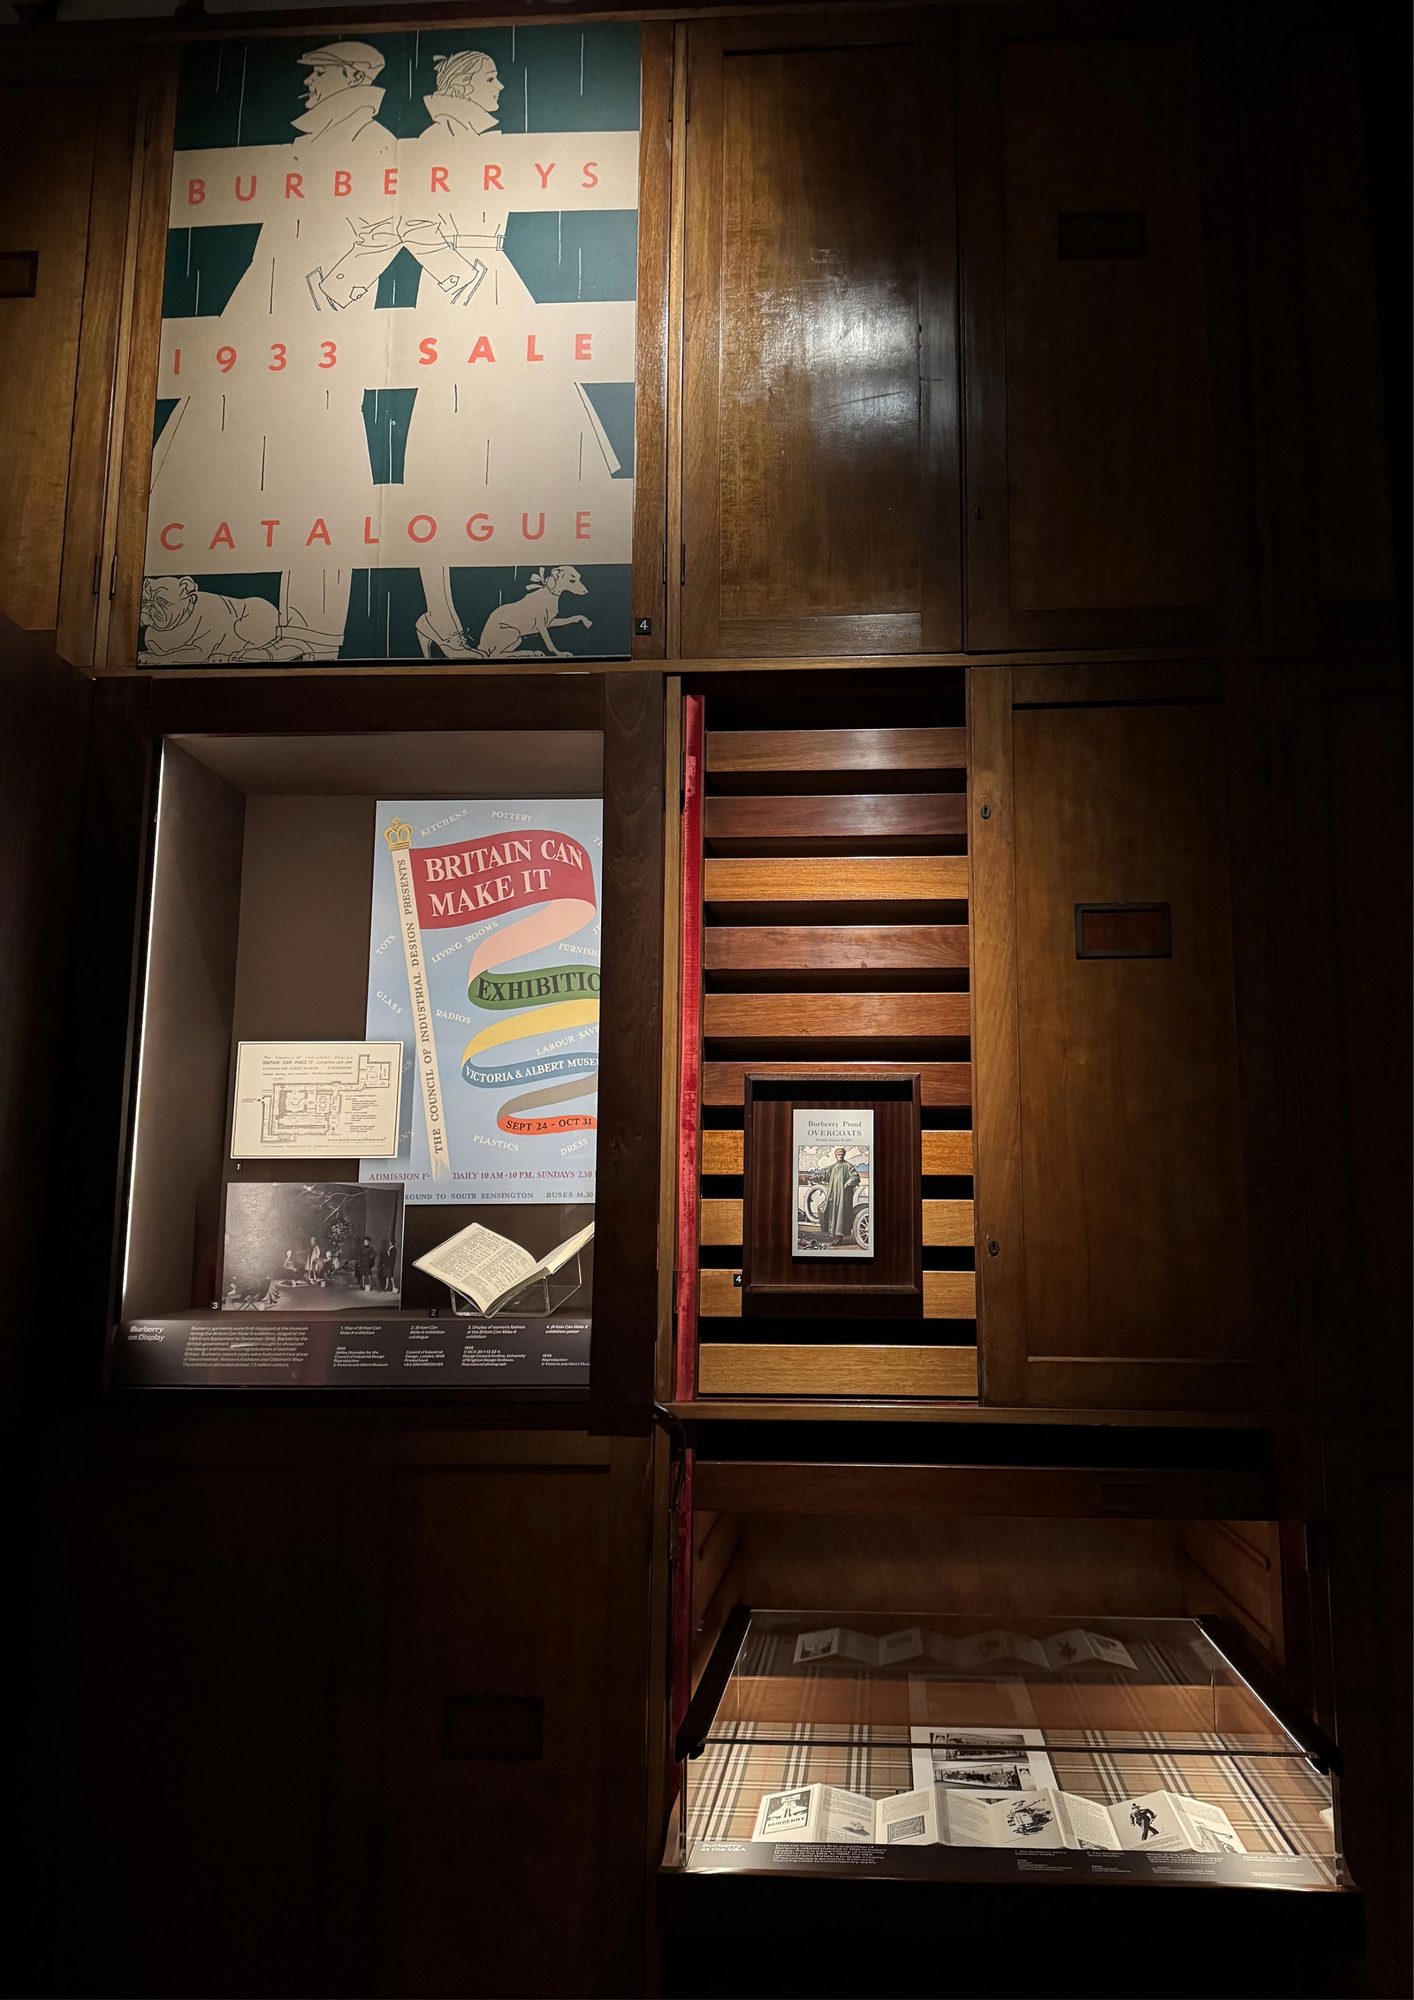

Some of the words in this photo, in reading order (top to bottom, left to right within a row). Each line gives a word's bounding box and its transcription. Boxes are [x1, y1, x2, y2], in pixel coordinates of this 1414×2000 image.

[186, 161, 600, 206] BURBERRYS
[173, 341, 338, 376] 1933
[418, 333, 593, 366] SALE
[159, 510, 592, 551] CATALOGUE
[640, 619, 649, 631] 4
[420, 808, 468, 837] KITCHENS
[491, 810, 533, 822] POTTERY
[424, 839, 533, 883] BRITAIN
[540, 839, 584, 871] CAN
[398, 859, 414, 915] PRESENTS
[428, 875, 515, 917] MAKE
[521, 868, 552, 893] IT
[375, 934, 396, 956] TOYS
[407, 922, 419, 967] DESIGN
[431, 941, 462, 964] LIVING
[465, 920, 499, 944] ROOMS
[558, 942, 600, 957] FURNISH
[476, 970, 601, 1002] EXHIBITIO
[376, 990, 404, 1015] GLASS
[413, 972, 430, 1043] INDUSTRIAL
[435, 1009, 472, 1025] RADIOS
[422, 1048, 432, 1064] OF
[535, 1035, 576, 1057] LABOUR
[465, 1065, 514, 1084] VICTORIA
[515, 1069, 523, 1079] &
[525, 1060, 566, 1078] ALBERT
[424, 1069, 440, 1123] COUNCIL
[506, 1119, 533, 1131] SEPT
[535, 1122, 548, 1131] 24
[558, 1118, 580, 1128] OCT
[582, 1117, 592, 1126] 31
[807, 1129, 862, 1137] OVERCOATS
[808, 1120, 839, 1129] Burberry
[843, 1120, 862, 1128] Proof
[434, 1128, 443, 1154] THE
[473, 1134, 520, 1152] PLASTICS
[560, 1138, 589, 1157] DRESS
[369, 1173, 420, 1181] ADMISSION
[453, 1172, 478, 1180] DAILY
[537, 1171, 575, 1179] SUNDAYS
[481, 1192, 534, 1200] KENSINGTON
[735, 1275, 742, 1284] 4
[212, 1302, 217, 1310] 3
[430, 1308, 436, 1317] 2
[130, 1325, 164, 1334] Burberry
[138, 1334, 165, 1342] Display
